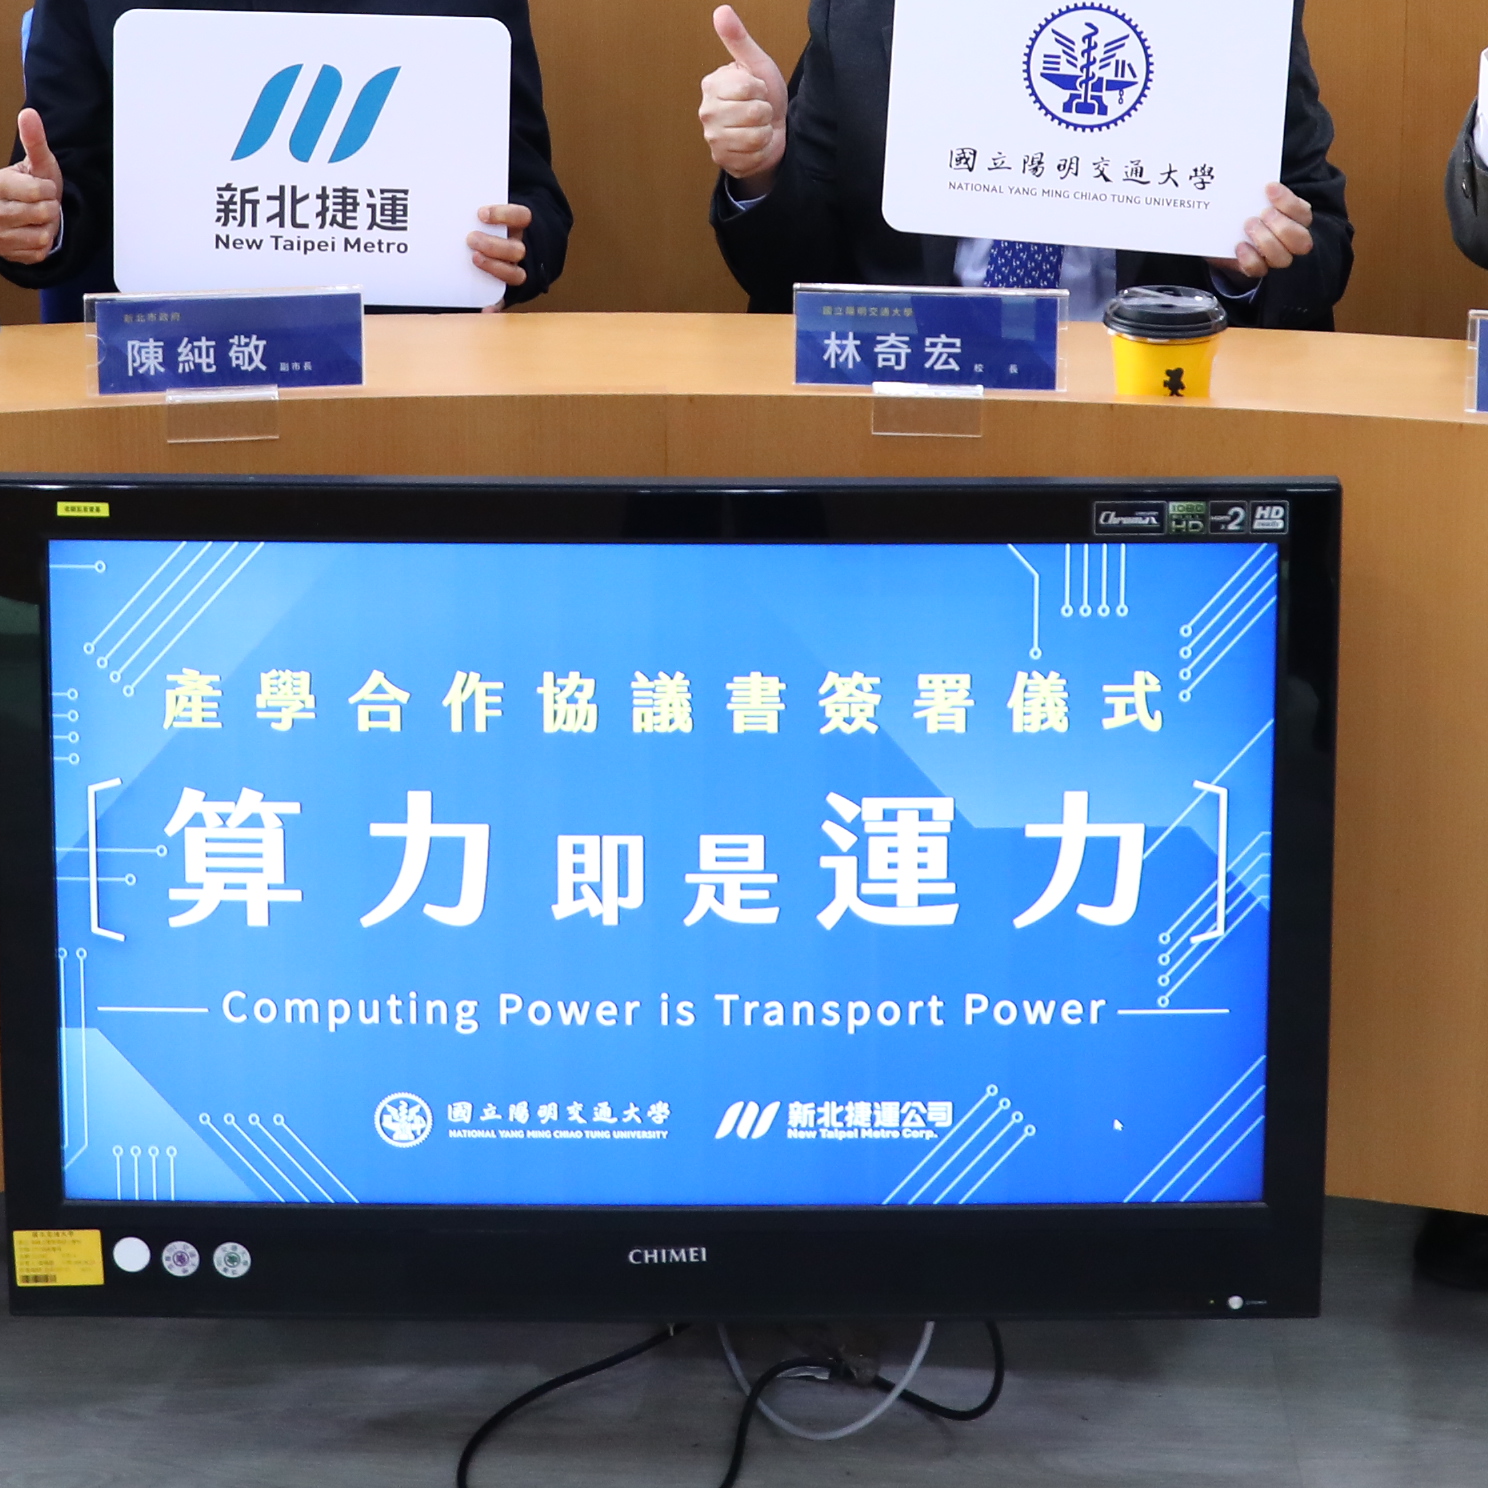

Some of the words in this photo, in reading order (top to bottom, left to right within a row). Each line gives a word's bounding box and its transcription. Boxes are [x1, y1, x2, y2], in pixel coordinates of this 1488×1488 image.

[949, 147, 1215, 190] 國立陽明交通大學
[215, 183, 409, 231] 新北捷運
[948, 181, 1004, 194] NATIONAL
[1007, 186, 1037, 197] YANG
[1041, 188, 1070, 200] MING
[1073, 191, 1108, 202] CHIAO
[1110, 193, 1142, 205] TUNG
[1144, 196, 1211, 210] UNIVERSITY
[215, 234, 263, 250] New
[270, 235, 335, 255] Taipei
[344, 237, 408, 253] Metro
[124, 312, 181, 323] 新北市政府
[127, 335, 267, 376] 陳純敬
[280, 362, 312, 371] 副市長
[822, 331, 962, 371] 林奇宏
[1171, 504, 1204, 512] 1080
[1256, 506, 1285, 519] HD
[1171, 520, 1204, 532] HD
[163, 668, 1164, 736] 產學合作協議書簽署儀式
[162, 786, 1149, 932] 算力即是運力
[220, 988, 480, 1034] Computing
[500, 991, 641, 1027] Power
[659, 988, 696, 1027] is
[714, 991, 945, 1036] Transport
[963, 991, 1108, 1027] Power
[447, 1100, 671, 1124] 國立陽明交通大學
[788, 1100, 954, 1128] 新北捷運公司
[448, 1129, 497, 1139] NATIONAL
[499, 1129, 525, 1139] YANG
[526, 1129, 552, 1139] MING
[553, 1129, 583, 1139] CHIAO
[584, 1129, 611, 1139] TUNG
[612, 1129, 669, 1139] UNIVERSITY
[787, 1128, 817, 1139] New
[819, 1128, 859, 1140] Taipei
[860, 1128, 900, 1139] Metro
[902, 1128, 938, 1140] Corp.
[628, 1247, 707, 1265] CHIMEI
